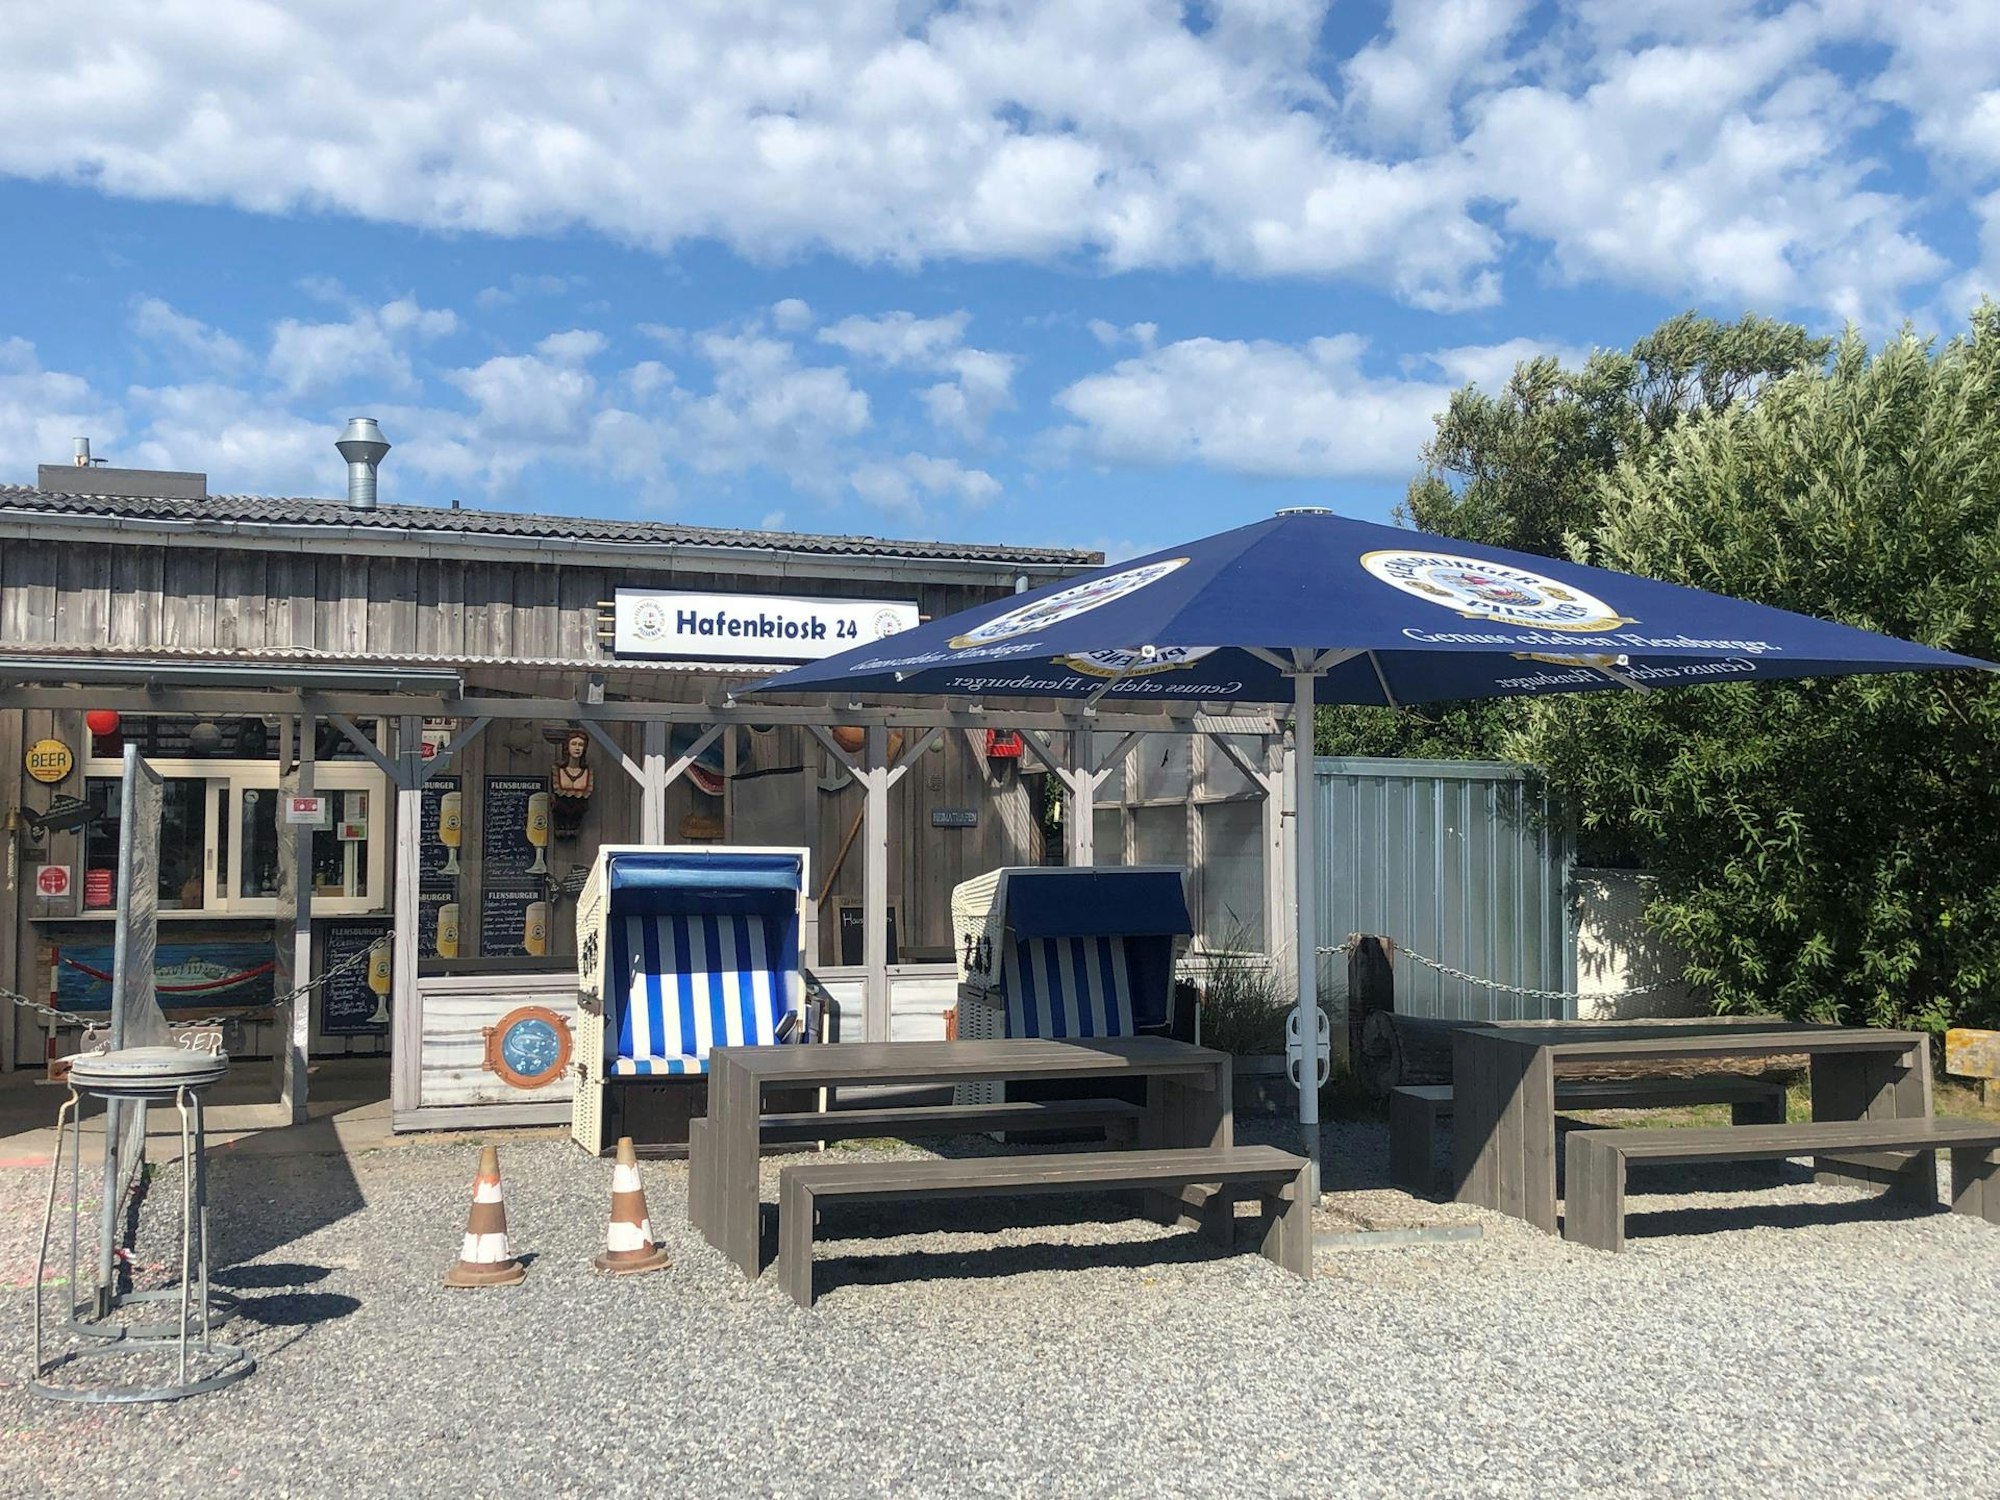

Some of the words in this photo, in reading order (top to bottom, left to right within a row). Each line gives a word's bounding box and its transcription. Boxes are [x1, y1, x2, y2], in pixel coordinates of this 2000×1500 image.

[1385, 556, 1540, 585] FLENSBURGER
[1466, 599, 1588, 621] PILSENER
[677, 610, 826, 640] Hafenkiosk
[836, 619, 858, 639] 24
[1402, 628, 1515, 645] Genuss
[1516, 631, 1628, 647] erleben.
[1614, 634, 1783, 654] Flensburger.
[31, 752, 66, 768] BEER
[491, 782, 541, 790] FLENSBURGER
[488, 892, 539, 900] FLENSBURGER
[331, 927, 385, 936] FLENSBURGER
